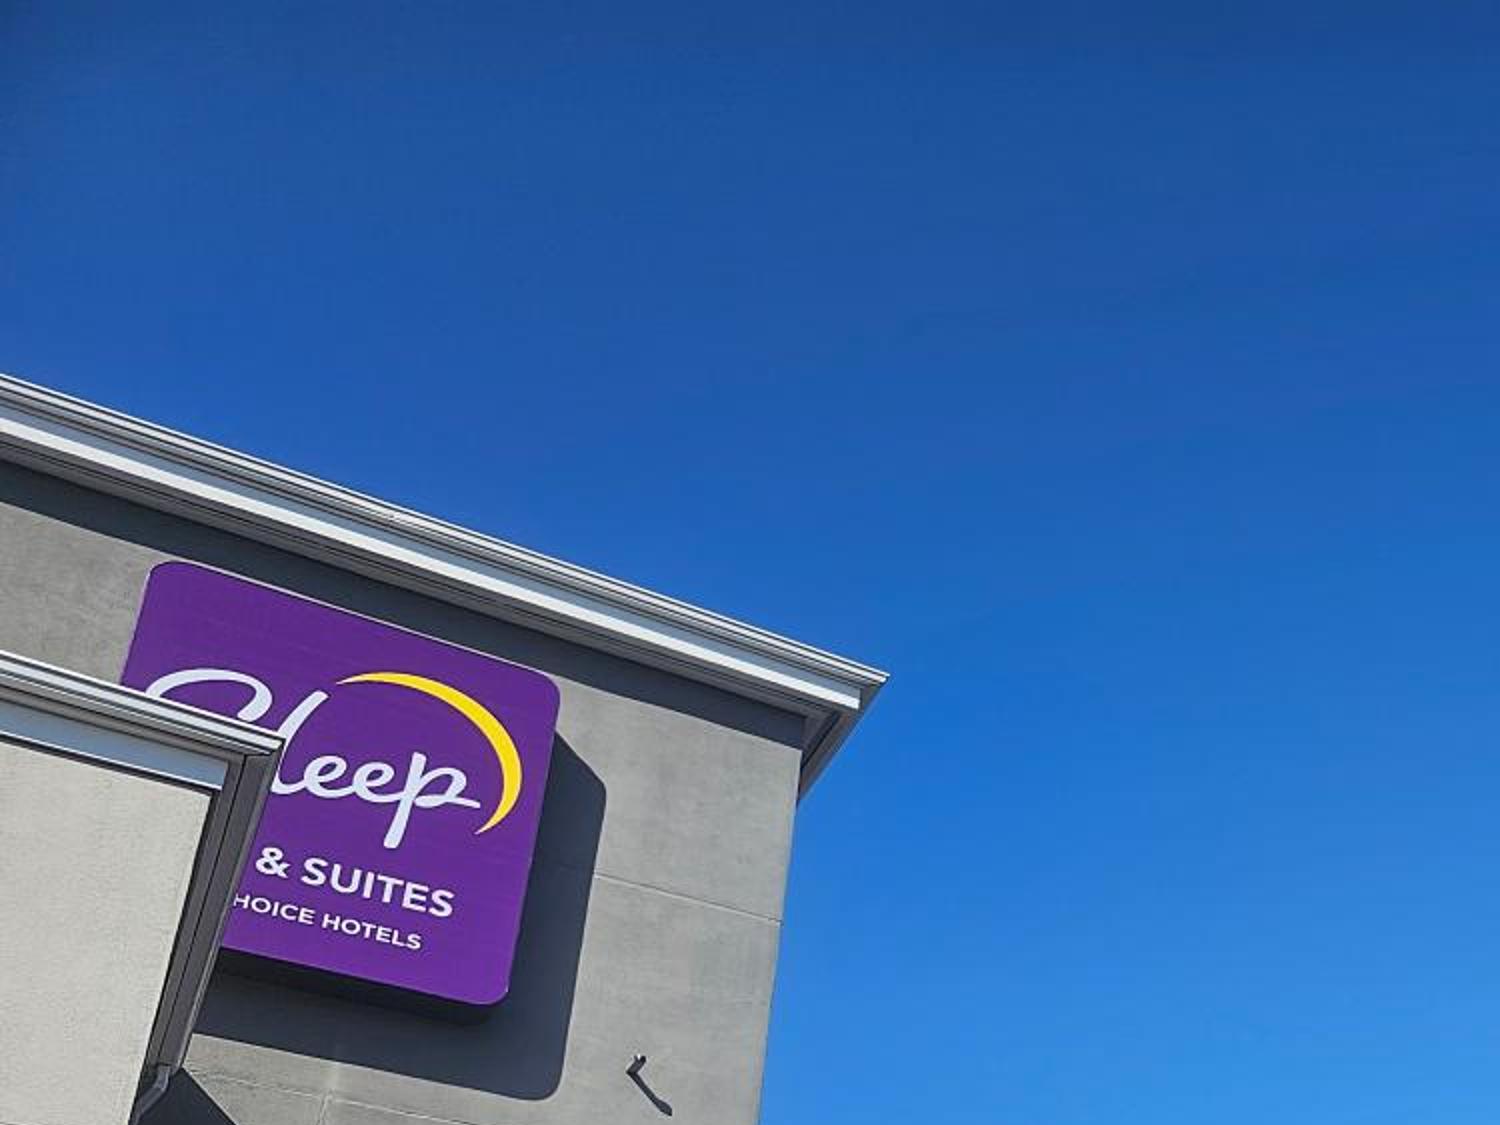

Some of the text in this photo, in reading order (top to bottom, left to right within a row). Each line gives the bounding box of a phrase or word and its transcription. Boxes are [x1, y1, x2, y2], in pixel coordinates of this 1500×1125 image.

[255, 847, 456, 918] & SUITES
[233, 893, 422, 950] HOICE HOTELS
